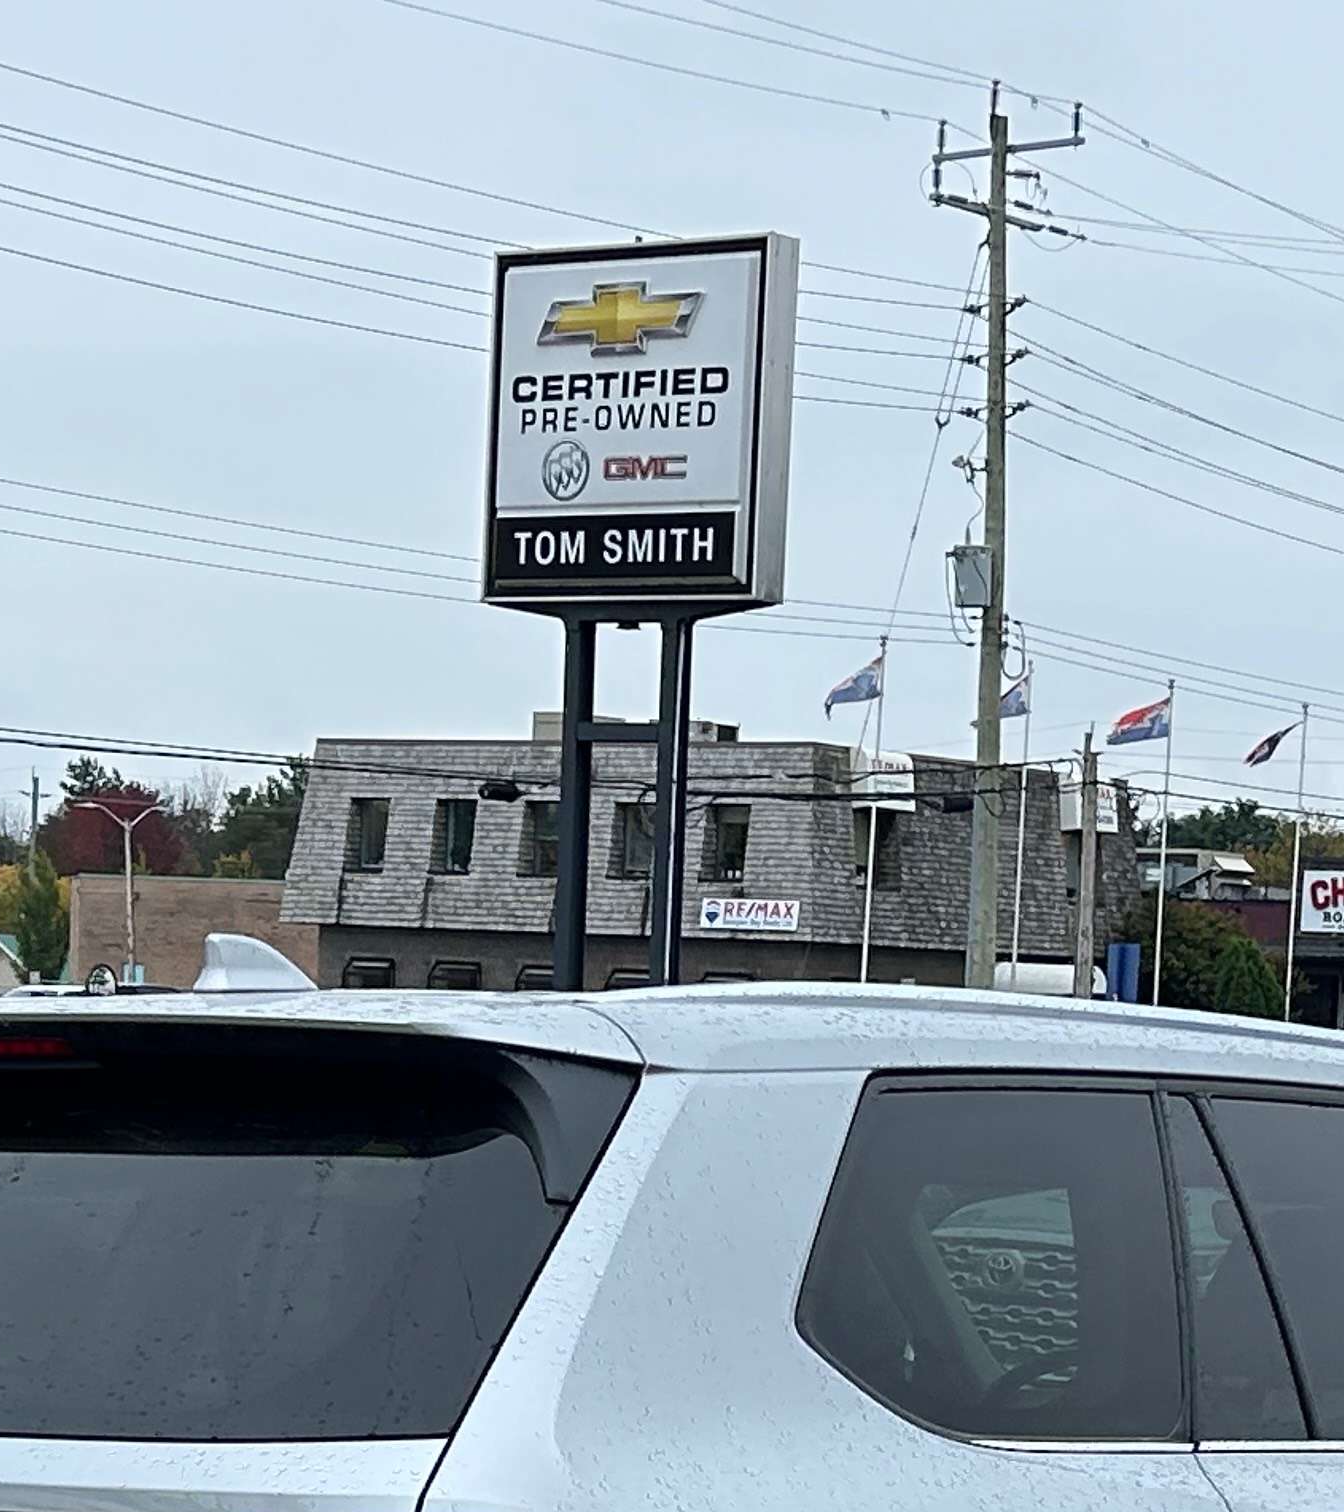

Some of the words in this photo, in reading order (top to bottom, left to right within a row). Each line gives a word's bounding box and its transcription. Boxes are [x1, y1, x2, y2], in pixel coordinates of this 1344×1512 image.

[512, 366, 729, 402] CERTIFIED
[521, 401, 717, 434] PRE-OWNED
[603, 454, 688, 481] GMC
[514, 530, 586, 565] TOM
[602, 527, 714, 564] SMITH
[723, 901, 795, 919] RE/MAX
